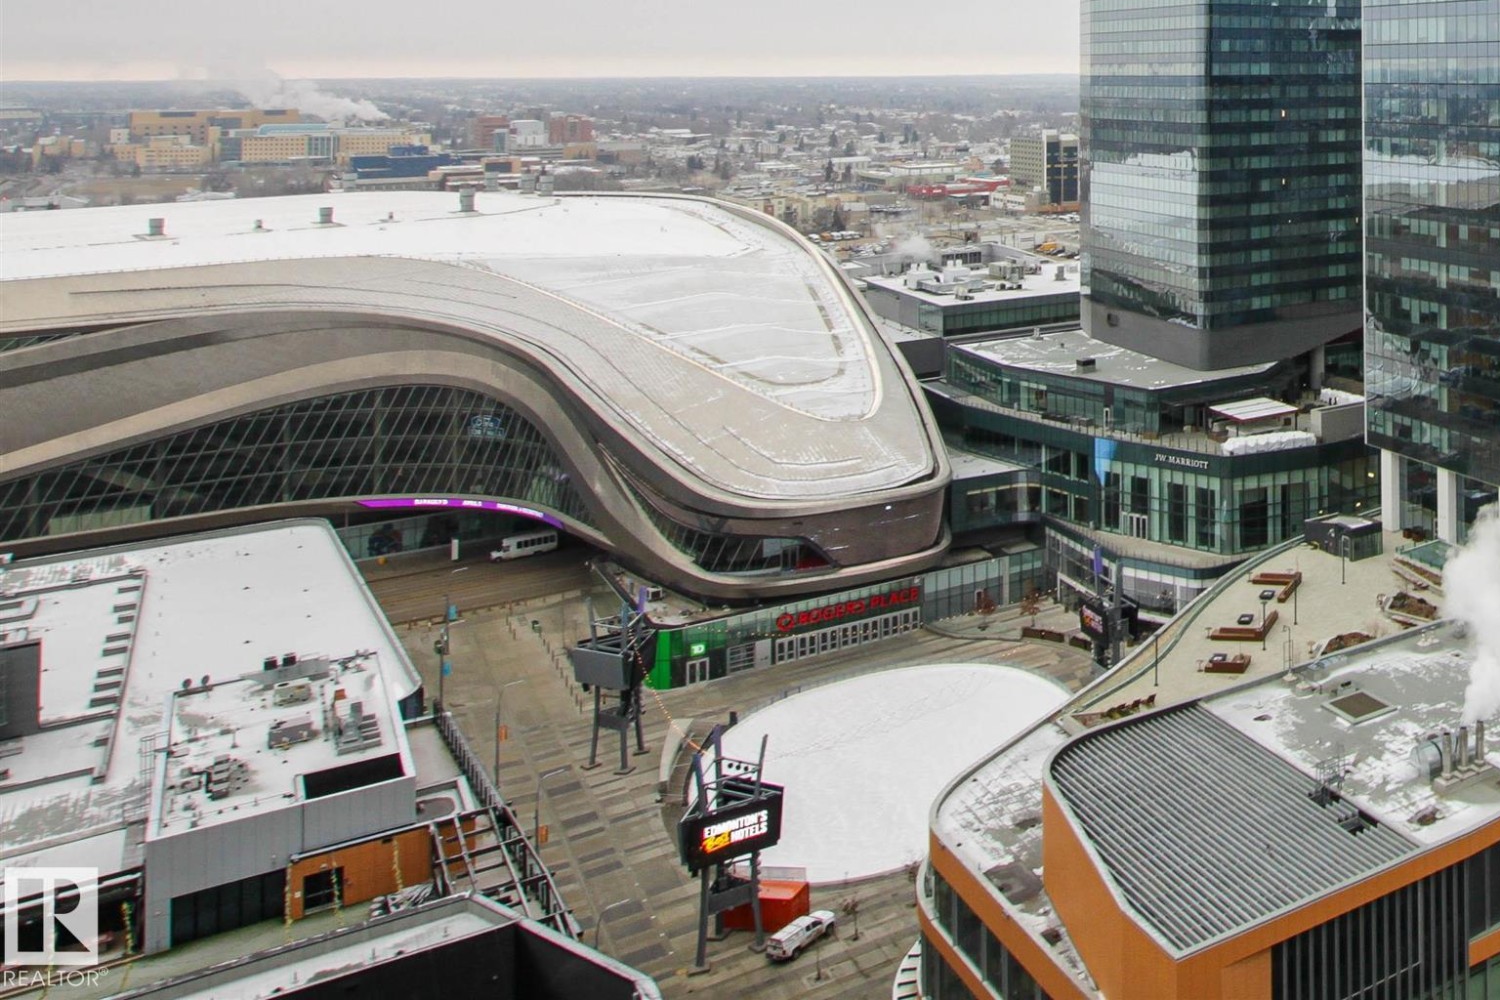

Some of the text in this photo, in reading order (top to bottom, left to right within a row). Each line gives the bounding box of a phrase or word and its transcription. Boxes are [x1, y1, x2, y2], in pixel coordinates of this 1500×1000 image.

[1168, 456, 1208, 469] MARRIOTT
[797, 587, 920, 626] ROGERS PLACE
[691, 644, 705, 654] TD
[703, 810, 768, 839] EDMONTON'S
[730, 822, 767, 842] HOTELS
